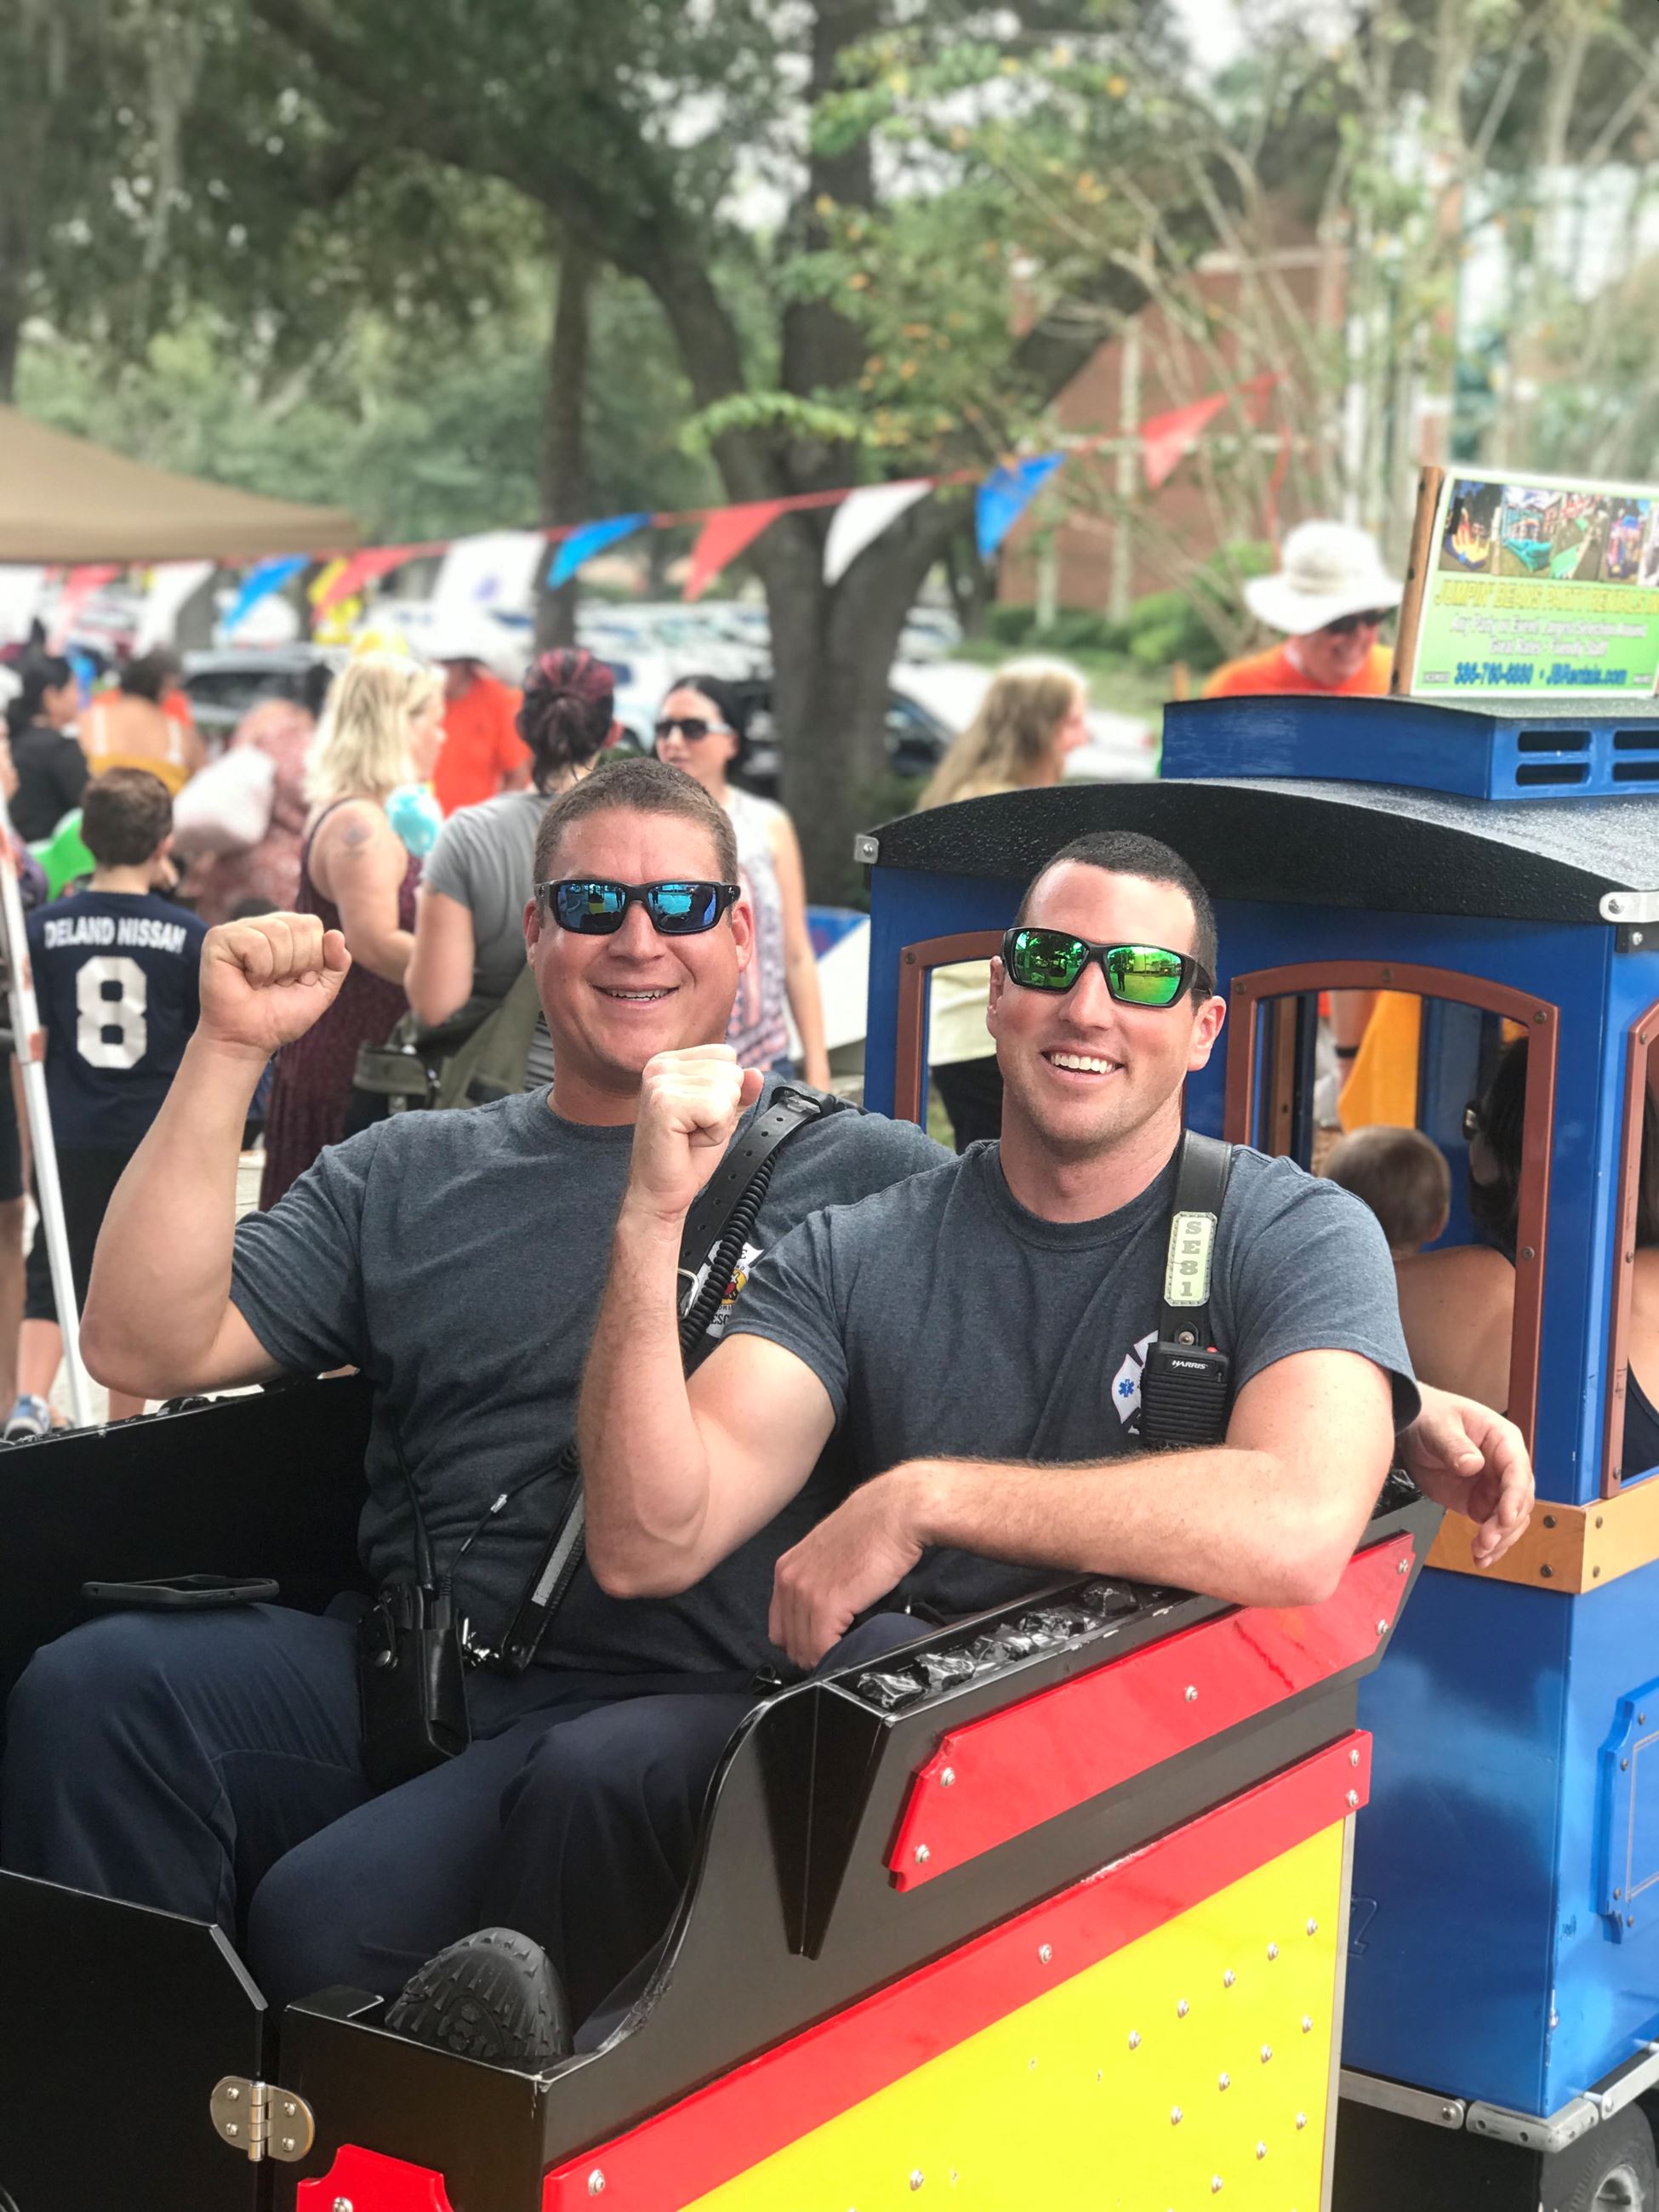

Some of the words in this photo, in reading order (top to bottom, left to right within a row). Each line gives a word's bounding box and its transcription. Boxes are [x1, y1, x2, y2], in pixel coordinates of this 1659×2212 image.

[44, 916, 116, 949] DELAND
[117, 917, 187, 954] NISSAN
[76, 955, 147, 1069] 8
[1172, 1360, 1206, 1370] HARRIS
